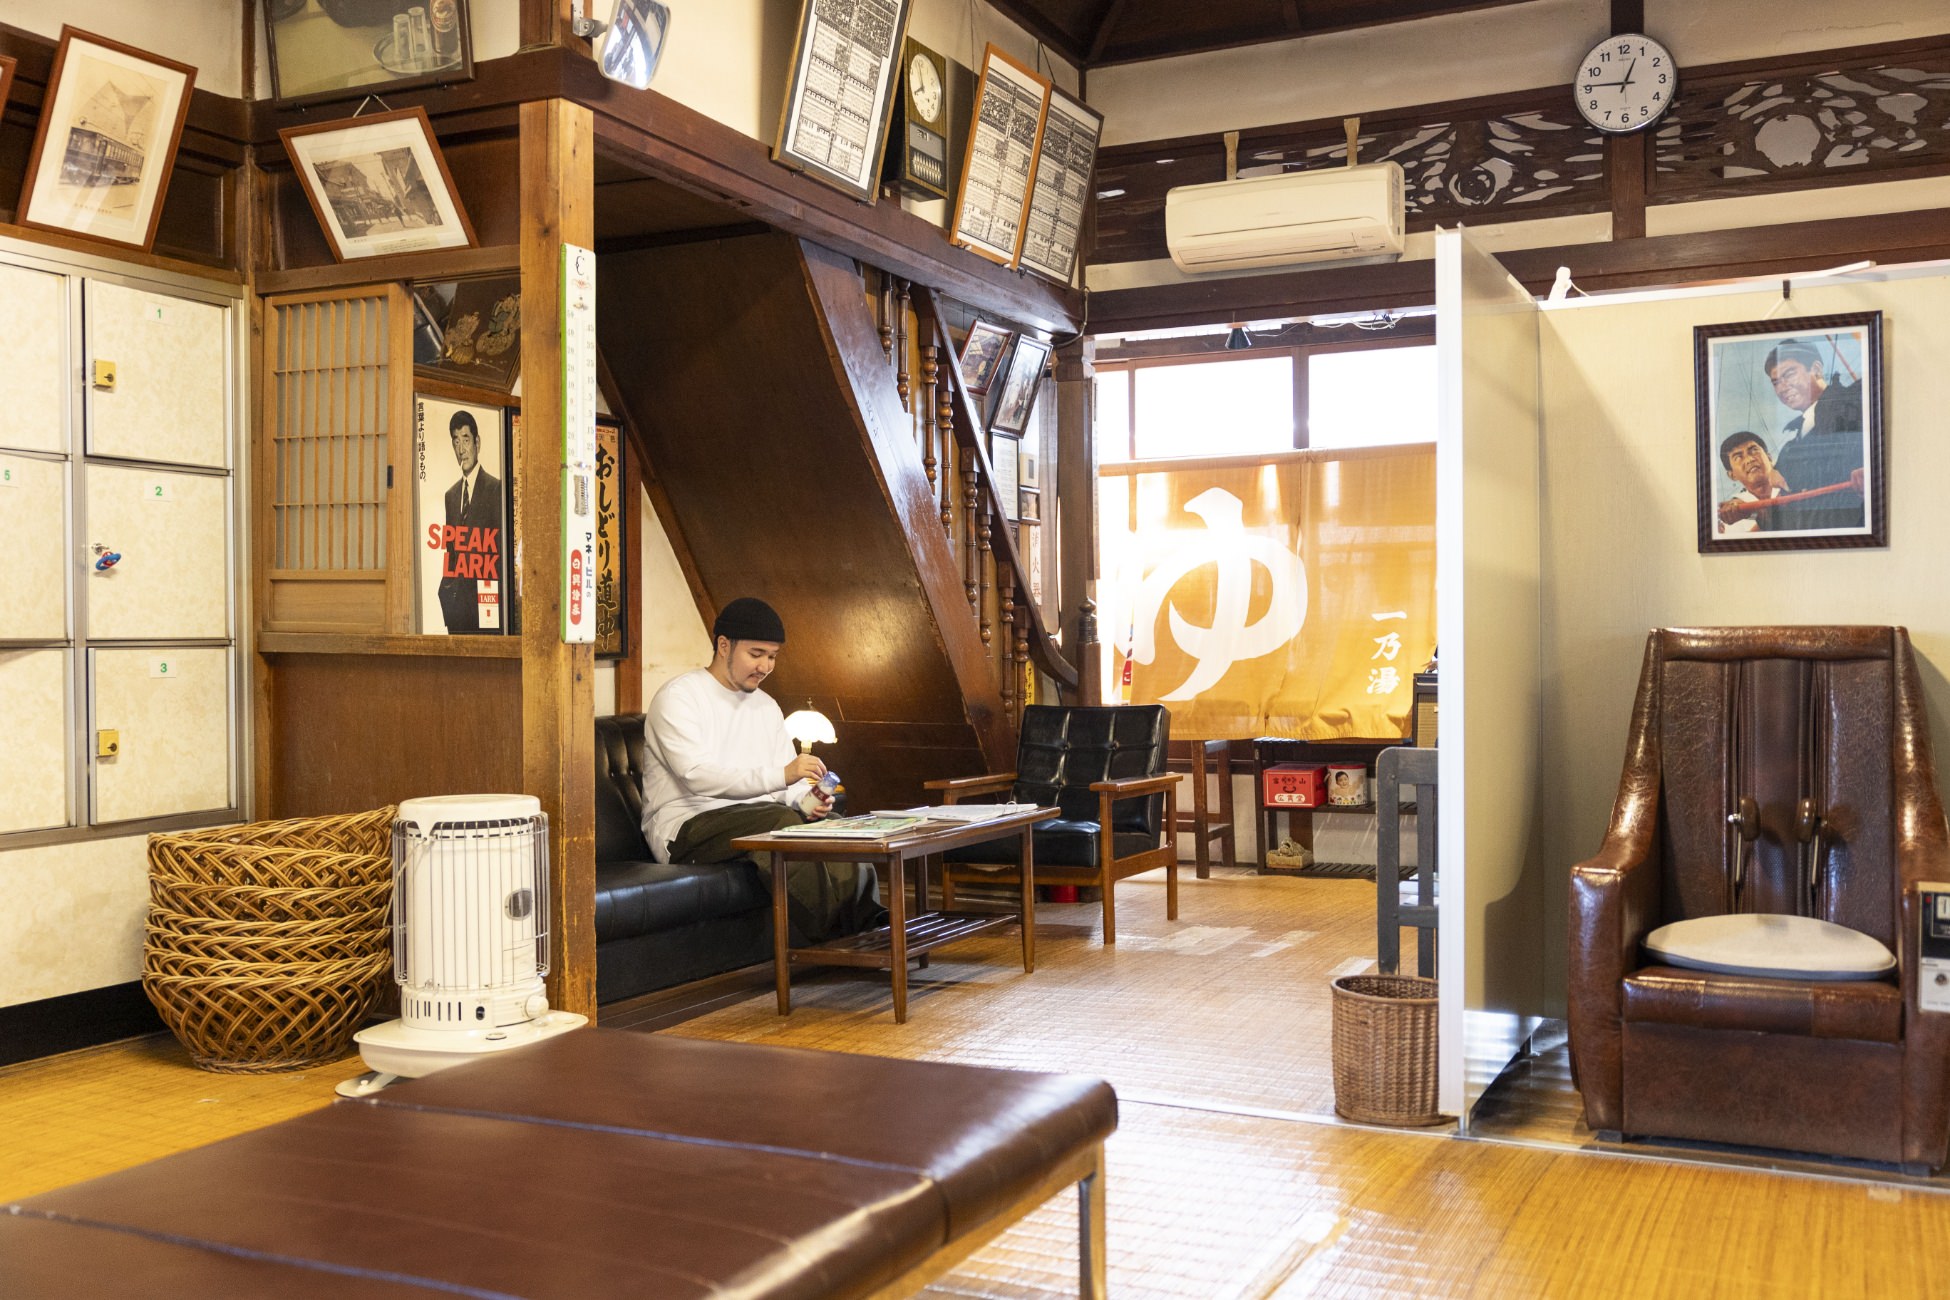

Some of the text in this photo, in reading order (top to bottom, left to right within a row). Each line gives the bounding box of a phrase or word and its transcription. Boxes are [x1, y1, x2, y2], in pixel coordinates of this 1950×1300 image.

[1618, 44, 1630, 55] 12
[1640, 46, 1645, 56] 1
[1600, 52, 1611, 62] 11
[1652, 57, 1660, 67] 2
[1588, 67, 1601, 77] 10
[1658, 74, 1666, 84] 3
[1584, 84, 1592, 94] 9
[1652, 92, 1661, 101] 4
[1590, 100, 1598, 110] 8
[1604, 111, 1612, 120] 7
[1640, 106, 1648, 116] 5
[1621, 113, 1629, 123] 6
[157, 308, 161, 319] 1
[417, 402, 426, 482] 言葉より語るもの。
[155, 486, 162, 496] 2
[427, 523, 499, 553] SPEAK
[596, 443, 617, 651] おしどり道中
[443, 552, 500, 579] LARK
[585, 532, 593, 598] マネービルの
[480, 594, 497, 603] LARK
[1113, 487, 1308, 702] ゆ
[1366, 611, 1407, 694] 一乃湯
[160, 662, 167, 673] 3
